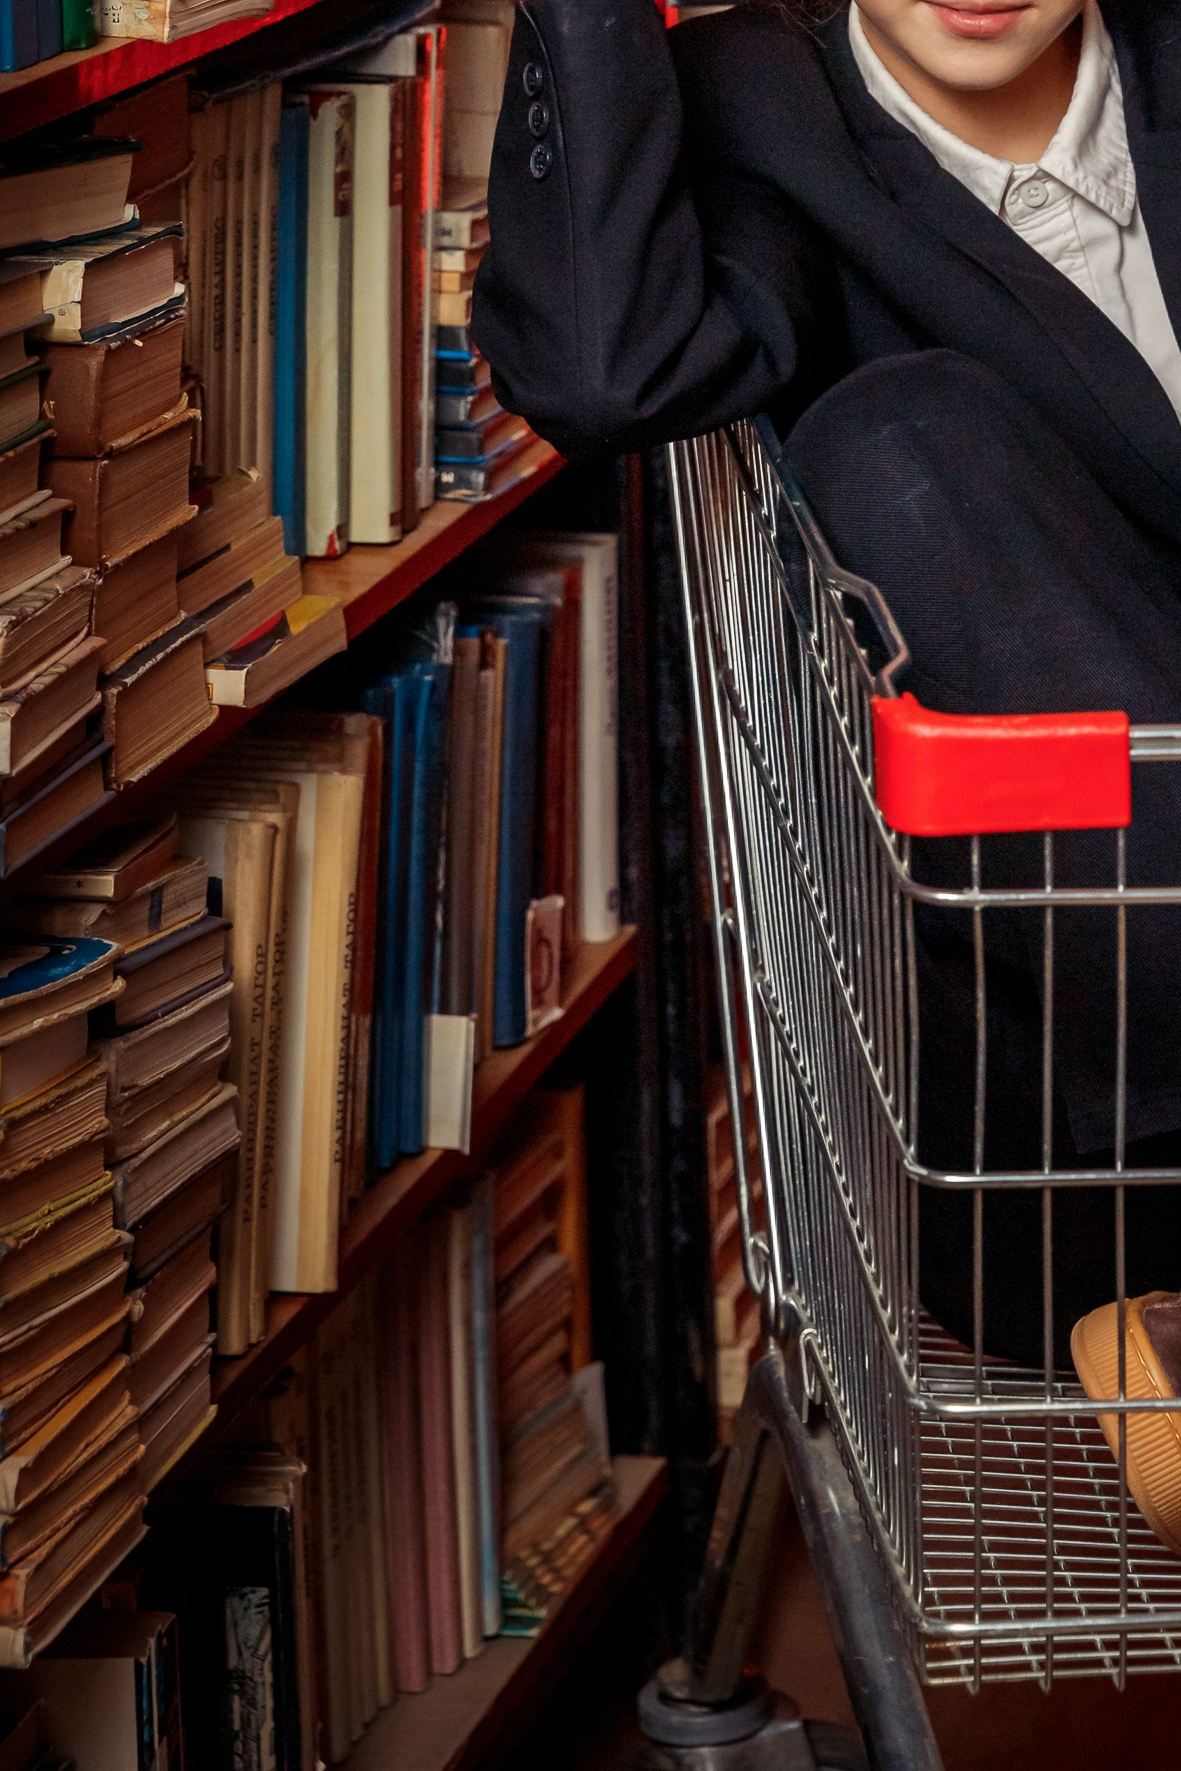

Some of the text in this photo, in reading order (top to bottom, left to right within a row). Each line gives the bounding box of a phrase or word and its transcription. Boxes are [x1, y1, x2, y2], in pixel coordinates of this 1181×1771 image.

[343, 892, 358, 970] ТАГОР
[242, 943, 268, 1223] РАБИНДРАНАТ ТАГОР
